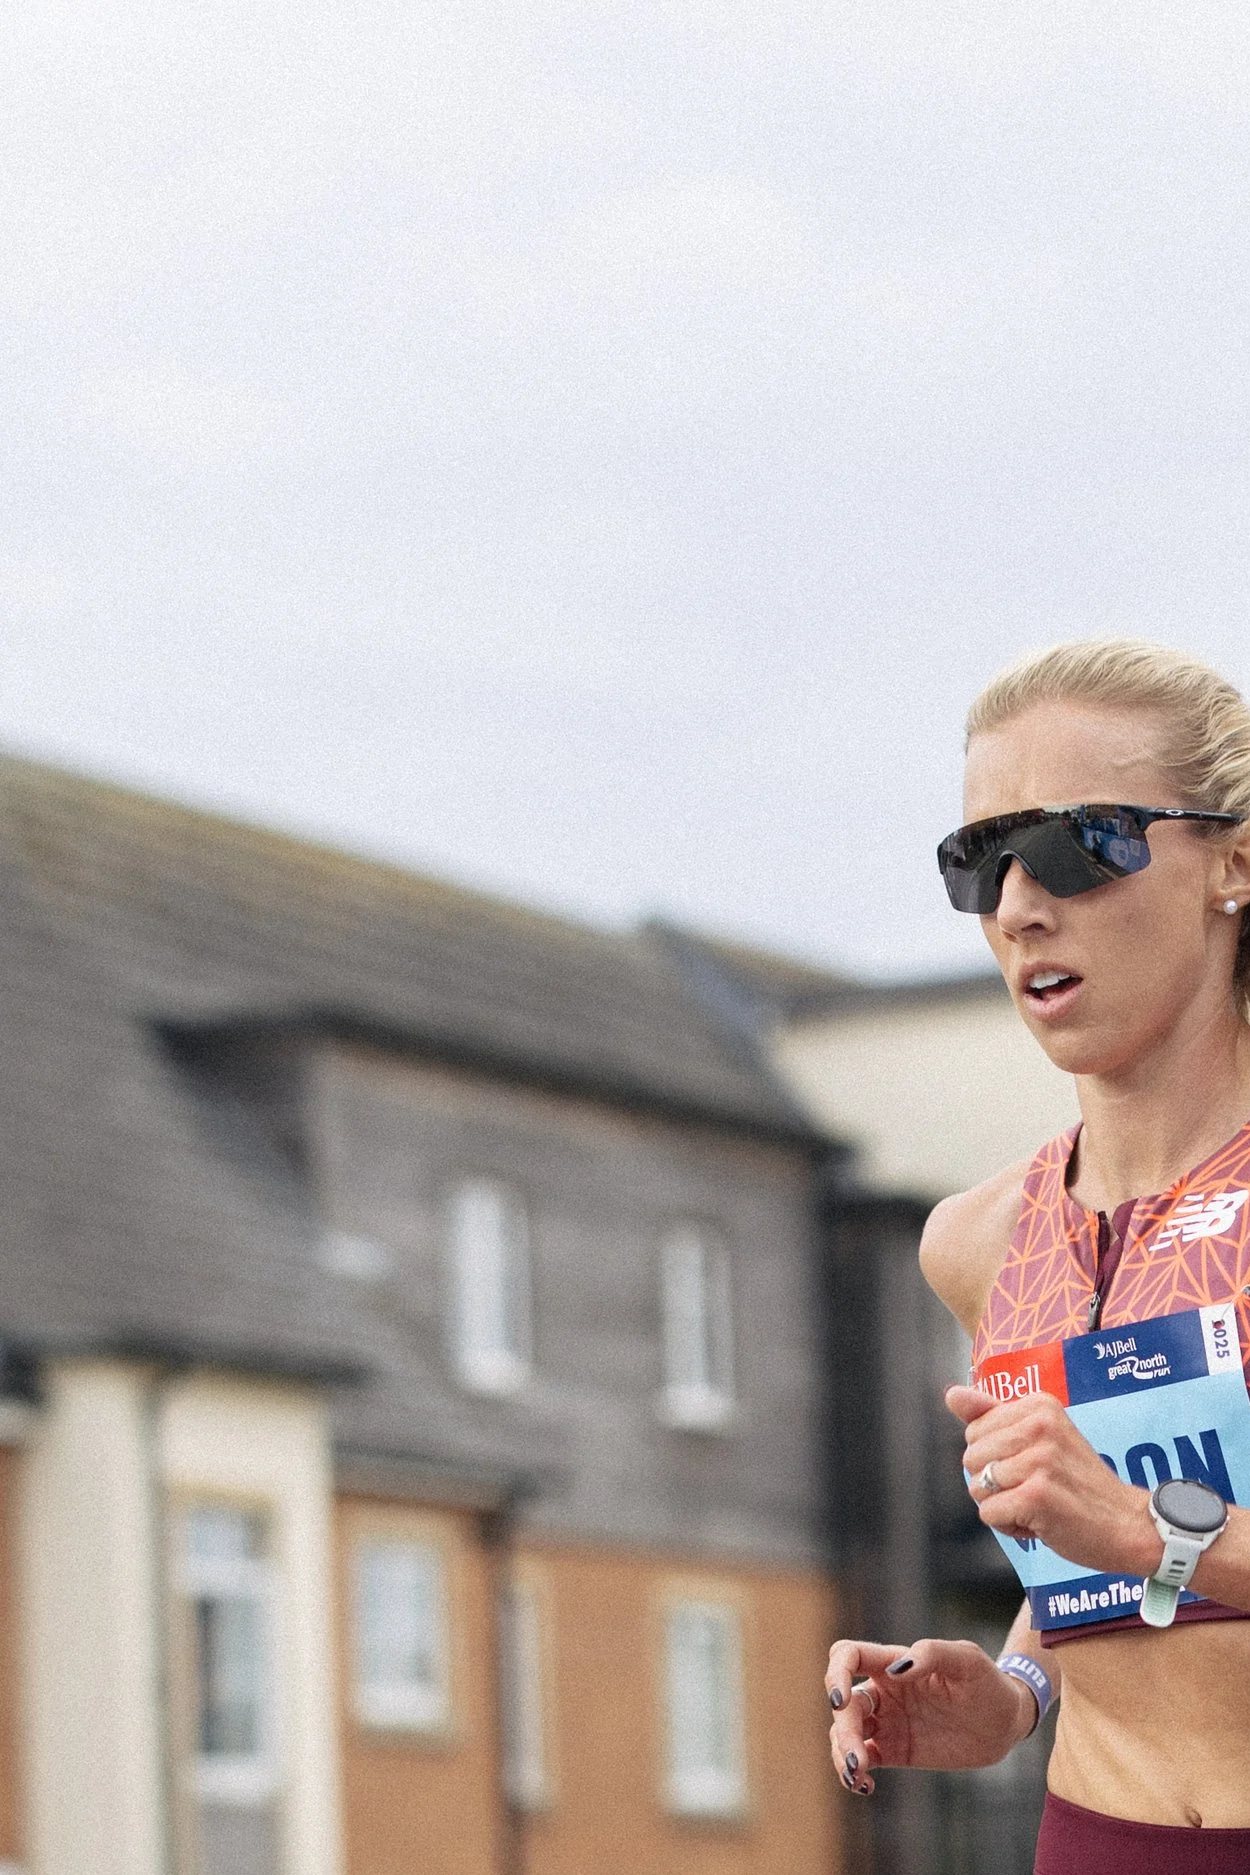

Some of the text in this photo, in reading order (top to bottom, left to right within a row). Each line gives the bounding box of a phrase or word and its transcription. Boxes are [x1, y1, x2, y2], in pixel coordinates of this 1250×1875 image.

[1107, 1352, 1167, 1381] great north
[1153, 1366, 1171, 1378] run
[1099, 1428, 1237, 1506] ON
[1007, 1655, 1048, 1689] ELITE
